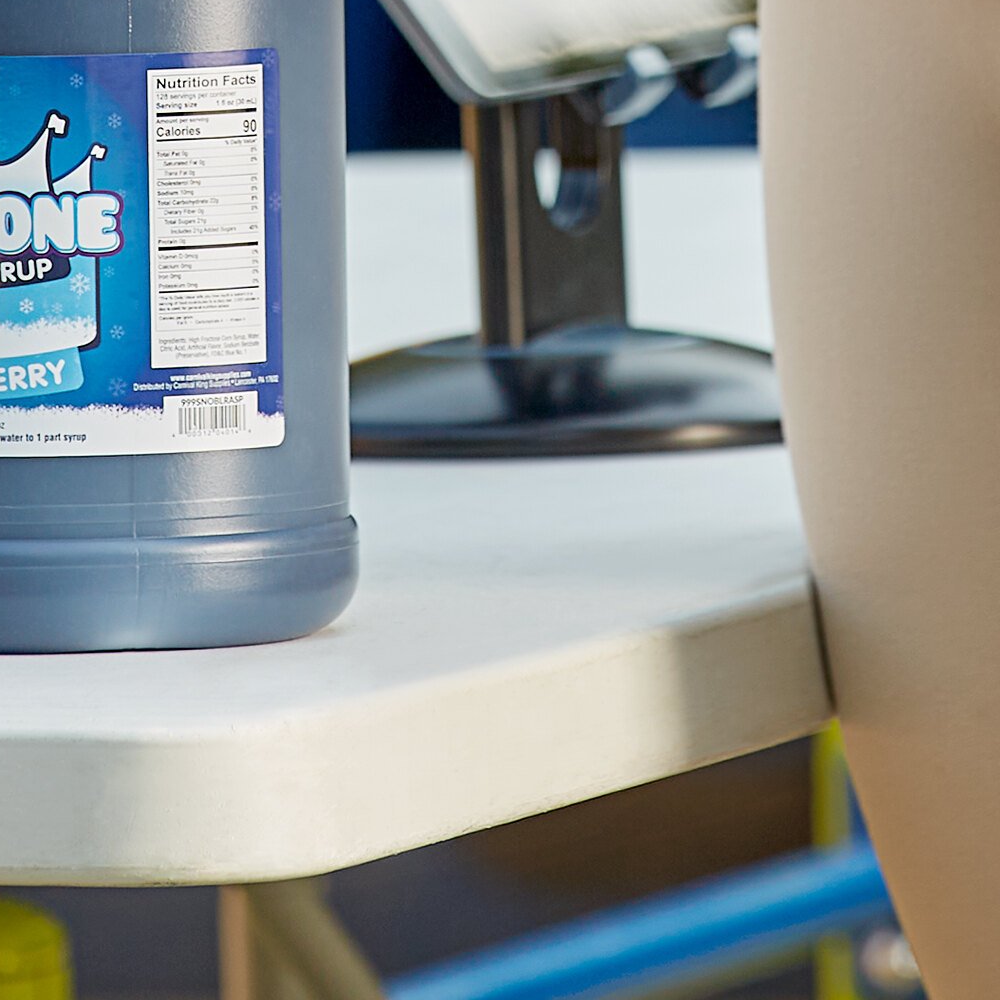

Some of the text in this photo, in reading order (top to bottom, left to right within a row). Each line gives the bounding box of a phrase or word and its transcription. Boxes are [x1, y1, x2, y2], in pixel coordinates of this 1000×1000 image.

[157, 75, 256, 89] Nutrition Facts
[157, 119, 256, 137] Calories 90
[166, 383, 172, 391] by
[0, 434, 23, 442] water
[26, 434, 34, 442] to
[44, 434, 61, 443] part
[64, 434, 86, 442] syrup
